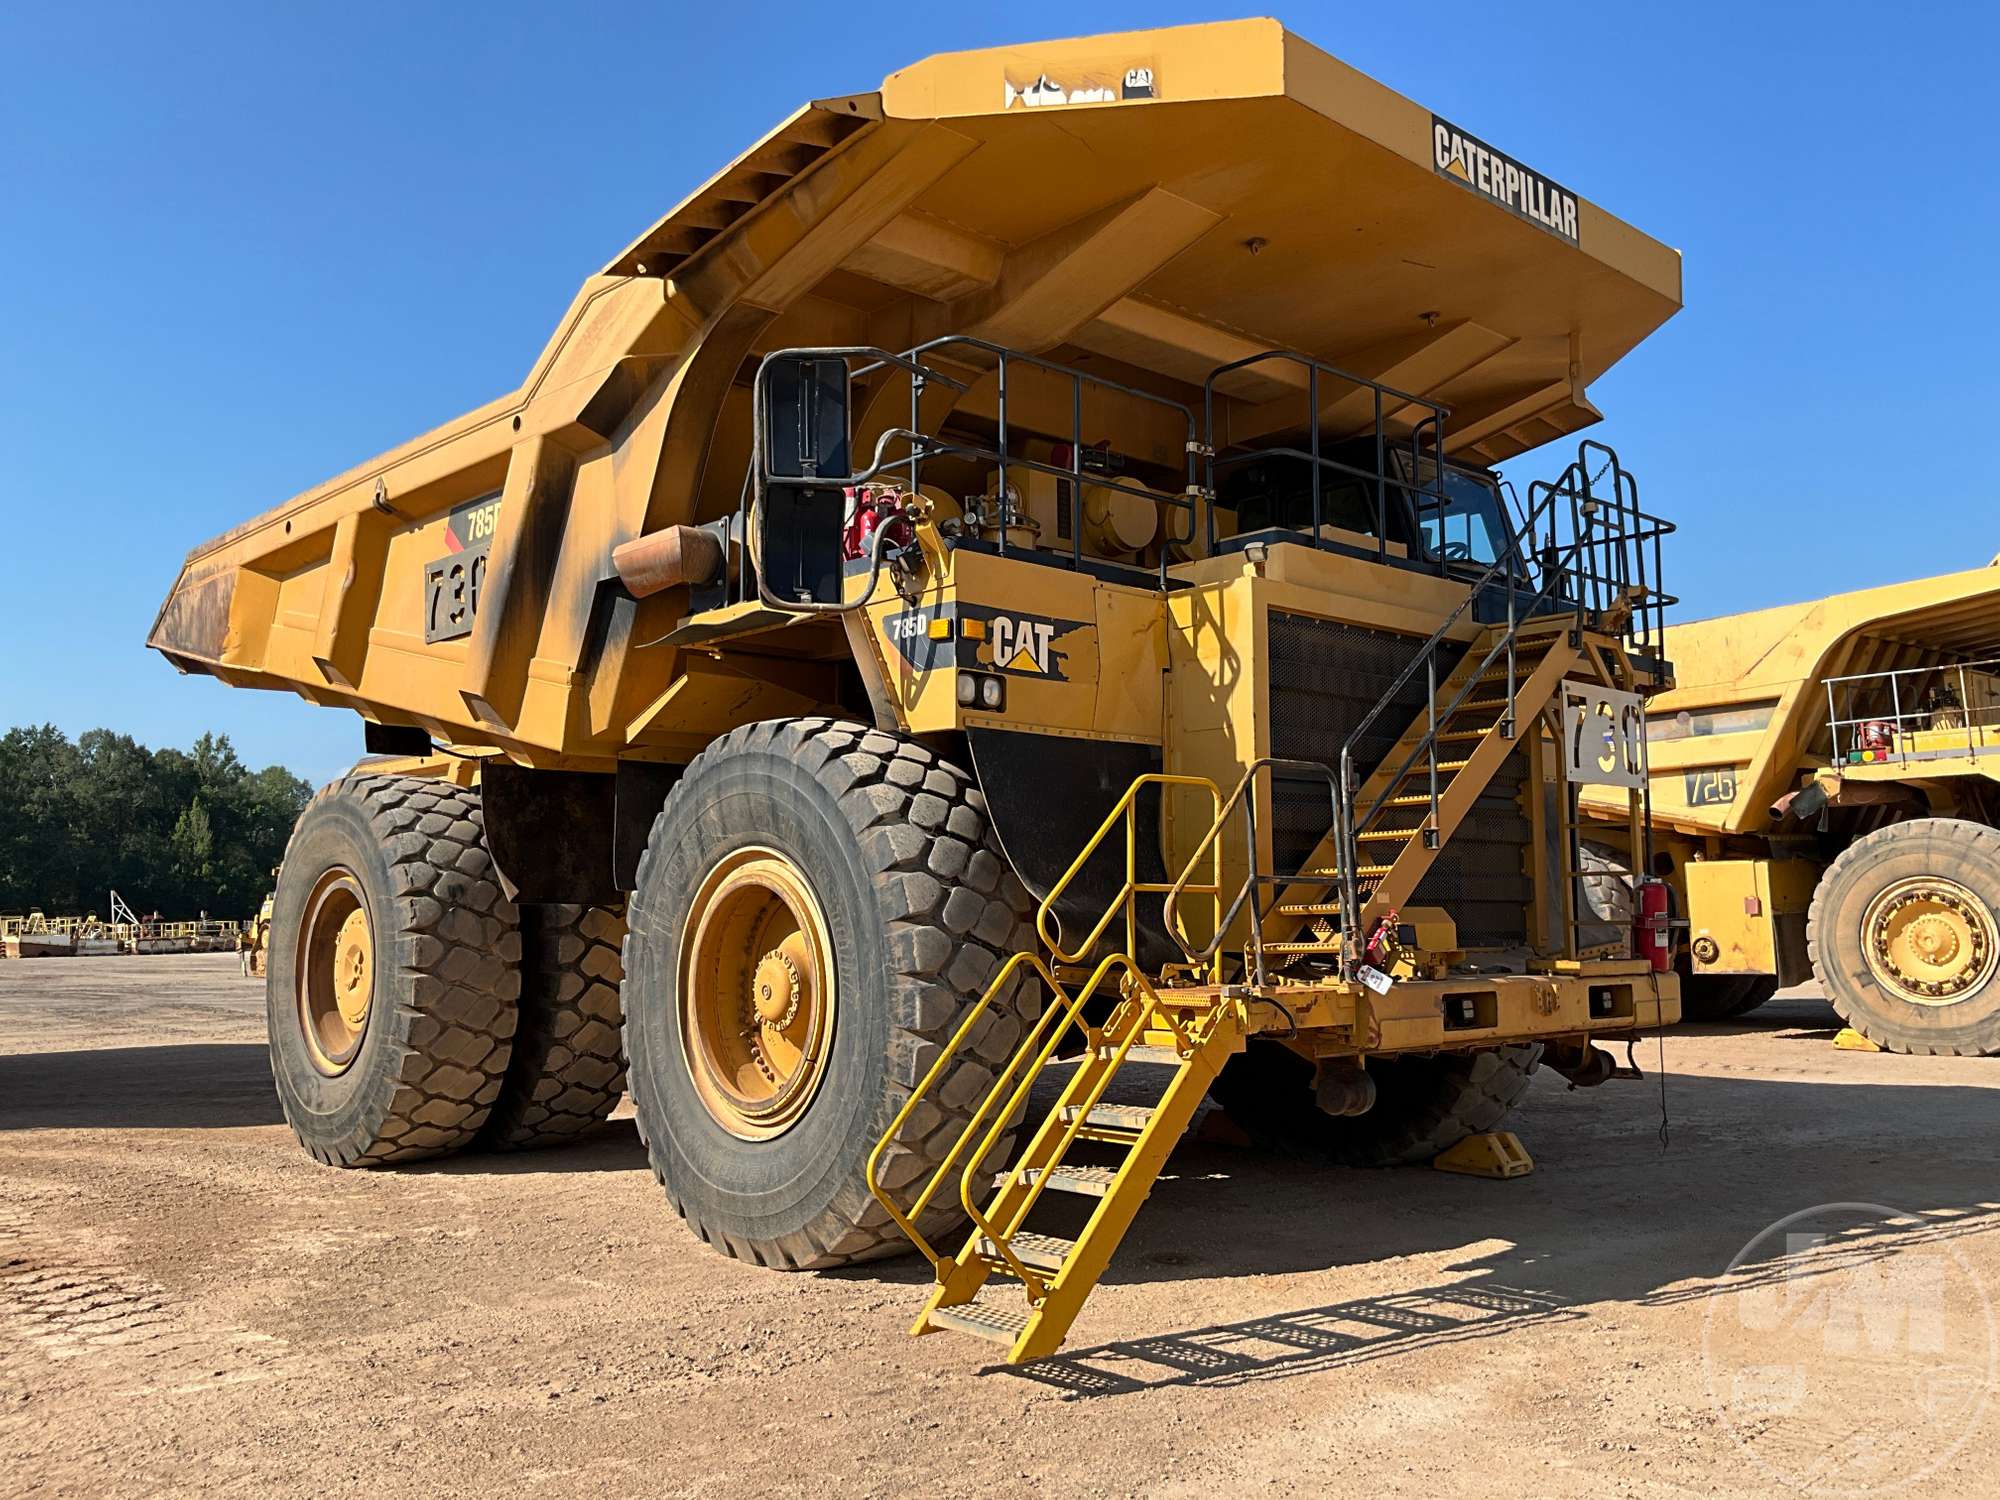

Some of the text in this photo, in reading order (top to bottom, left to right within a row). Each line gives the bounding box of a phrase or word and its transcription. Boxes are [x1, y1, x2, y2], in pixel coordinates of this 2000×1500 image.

[1434, 123, 1578, 241] CATERPILLAR
[893, 614, 927, 641] 785D
[993, 616, 1054, 674] CAT
[1567, 694, 1642, 775] 730
